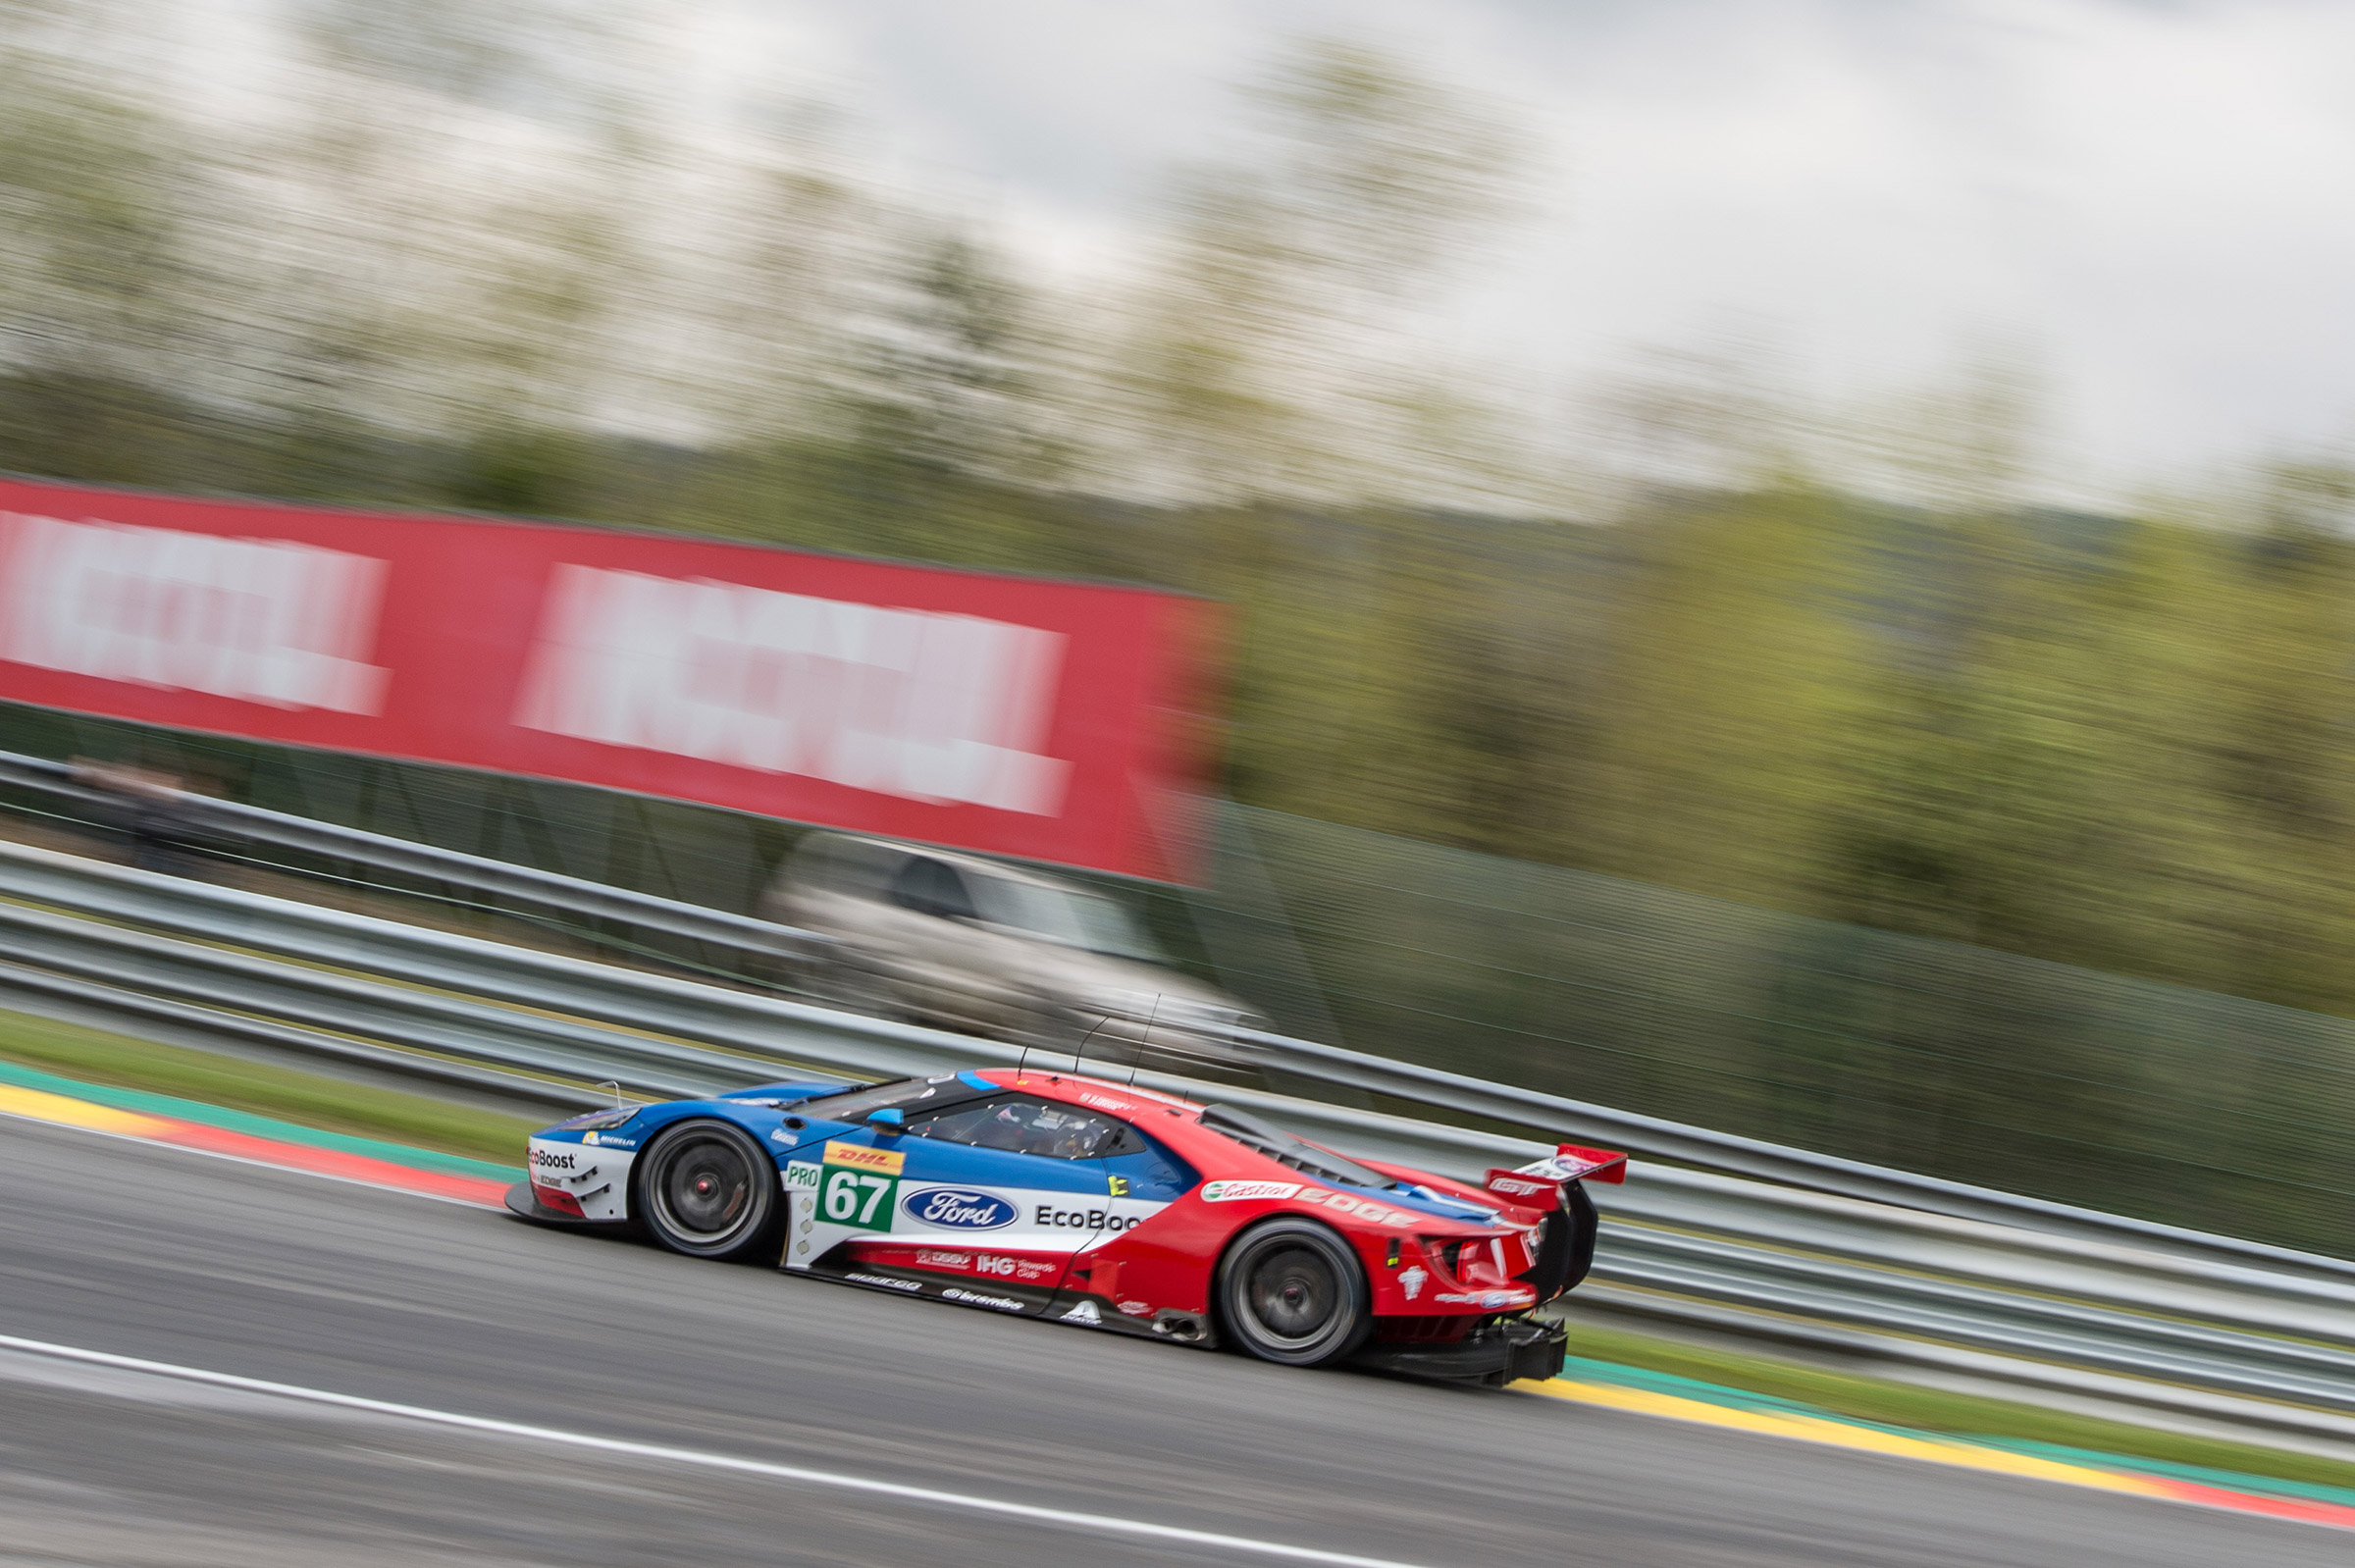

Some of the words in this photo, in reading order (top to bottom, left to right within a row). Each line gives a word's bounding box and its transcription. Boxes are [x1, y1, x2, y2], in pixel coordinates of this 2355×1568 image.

[601, 1135, 636, 1146] MICHELIN
[837, 1149, 889, 1166] DHL
[788, 1166, 818, 1186] PRO
[1489, 1177, 1555, 1196] GT
[824, 1172, 891, 1224] 67
[1224, 1183, 1291, 1197] Castrol
[1293, 1187, 1422, 1228] EDGE
[923, 1191, 999, 1226] Ford
[1035, 1205, 1142, 1231] EcoBoo
[976, 1255, 1016, 1276] IHG
[959, 1291, 1025, 1310] brembo
